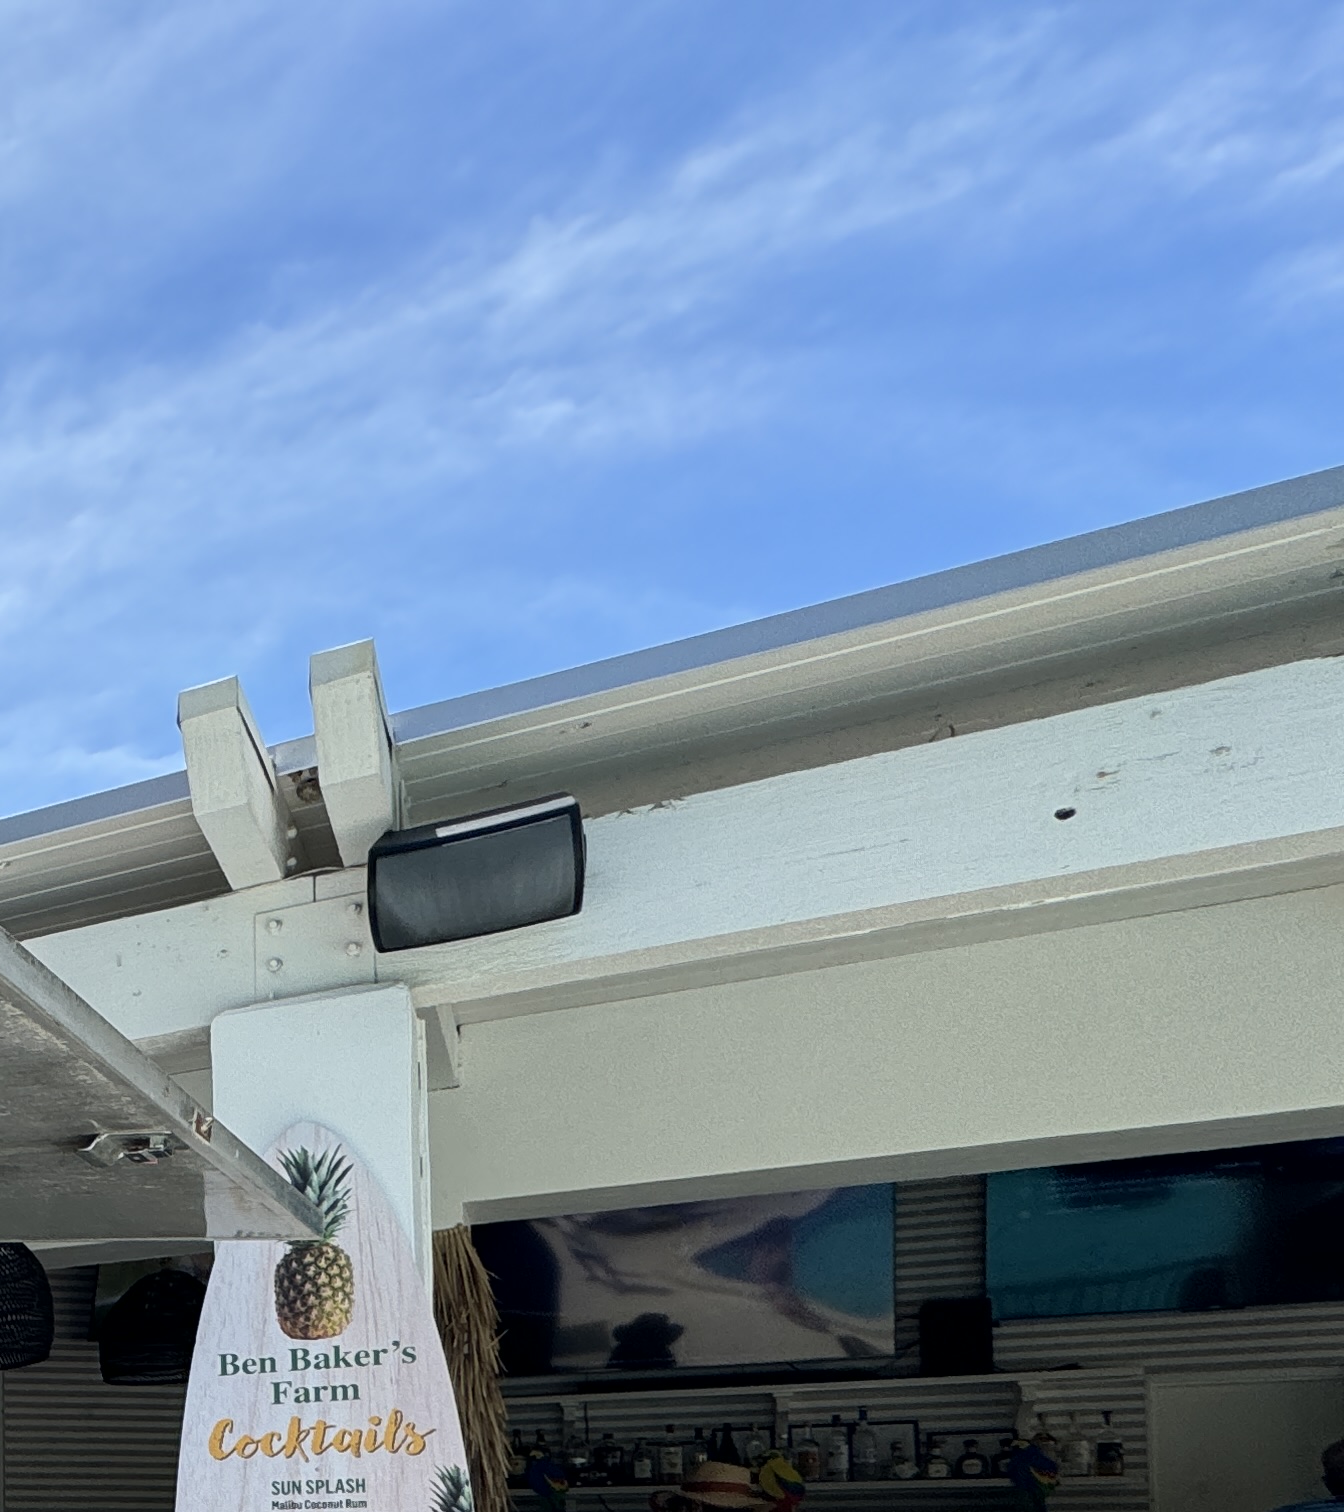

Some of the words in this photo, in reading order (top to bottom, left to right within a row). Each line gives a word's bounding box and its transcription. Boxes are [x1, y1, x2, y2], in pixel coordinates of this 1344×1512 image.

[218, 1353, 277, 1376] Ben
[289, 1341, 417, 1372] Baker’s
[271, 1381, 360, 1405] Farm
[208, 1408, 436, 1463] Cocktails
[271, 1480, 302, 1495] SUN
[305, 1478, 366, 1494] SPLASH
[271, 1500, 302, 1510] Malibu
[304, 1500, 343, 1509] Coconut
[346, 1499, 367, 1508] Rum
